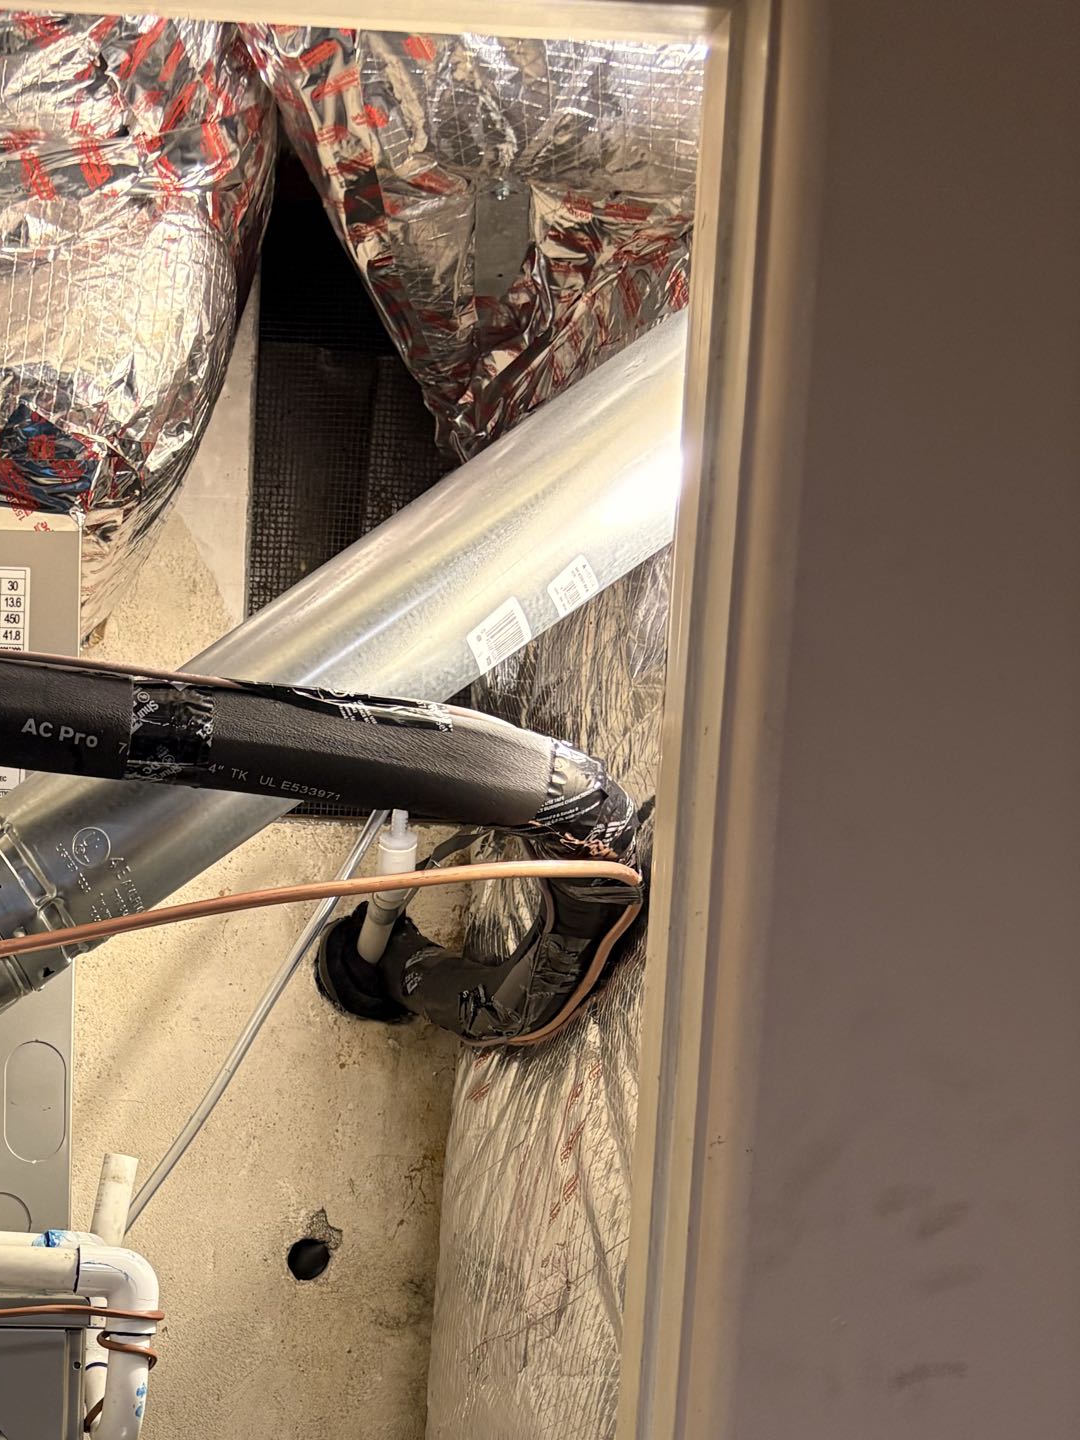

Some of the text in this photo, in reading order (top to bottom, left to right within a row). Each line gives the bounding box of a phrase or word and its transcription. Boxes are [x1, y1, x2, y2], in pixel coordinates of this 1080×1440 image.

[8, 580, 18, 591] 30
[5, 597, 22, 608] 13.6
[4, 614, 20, 624] 450
[3, 630, 20, 640] 41.8
[21, 718, 54, 738] AC
[58, 725, 98, 748] Pro
[230, 768, 249, 782] TK
[260, 775, 276, 788] UL
[280, 780, 341, 801] E533971
